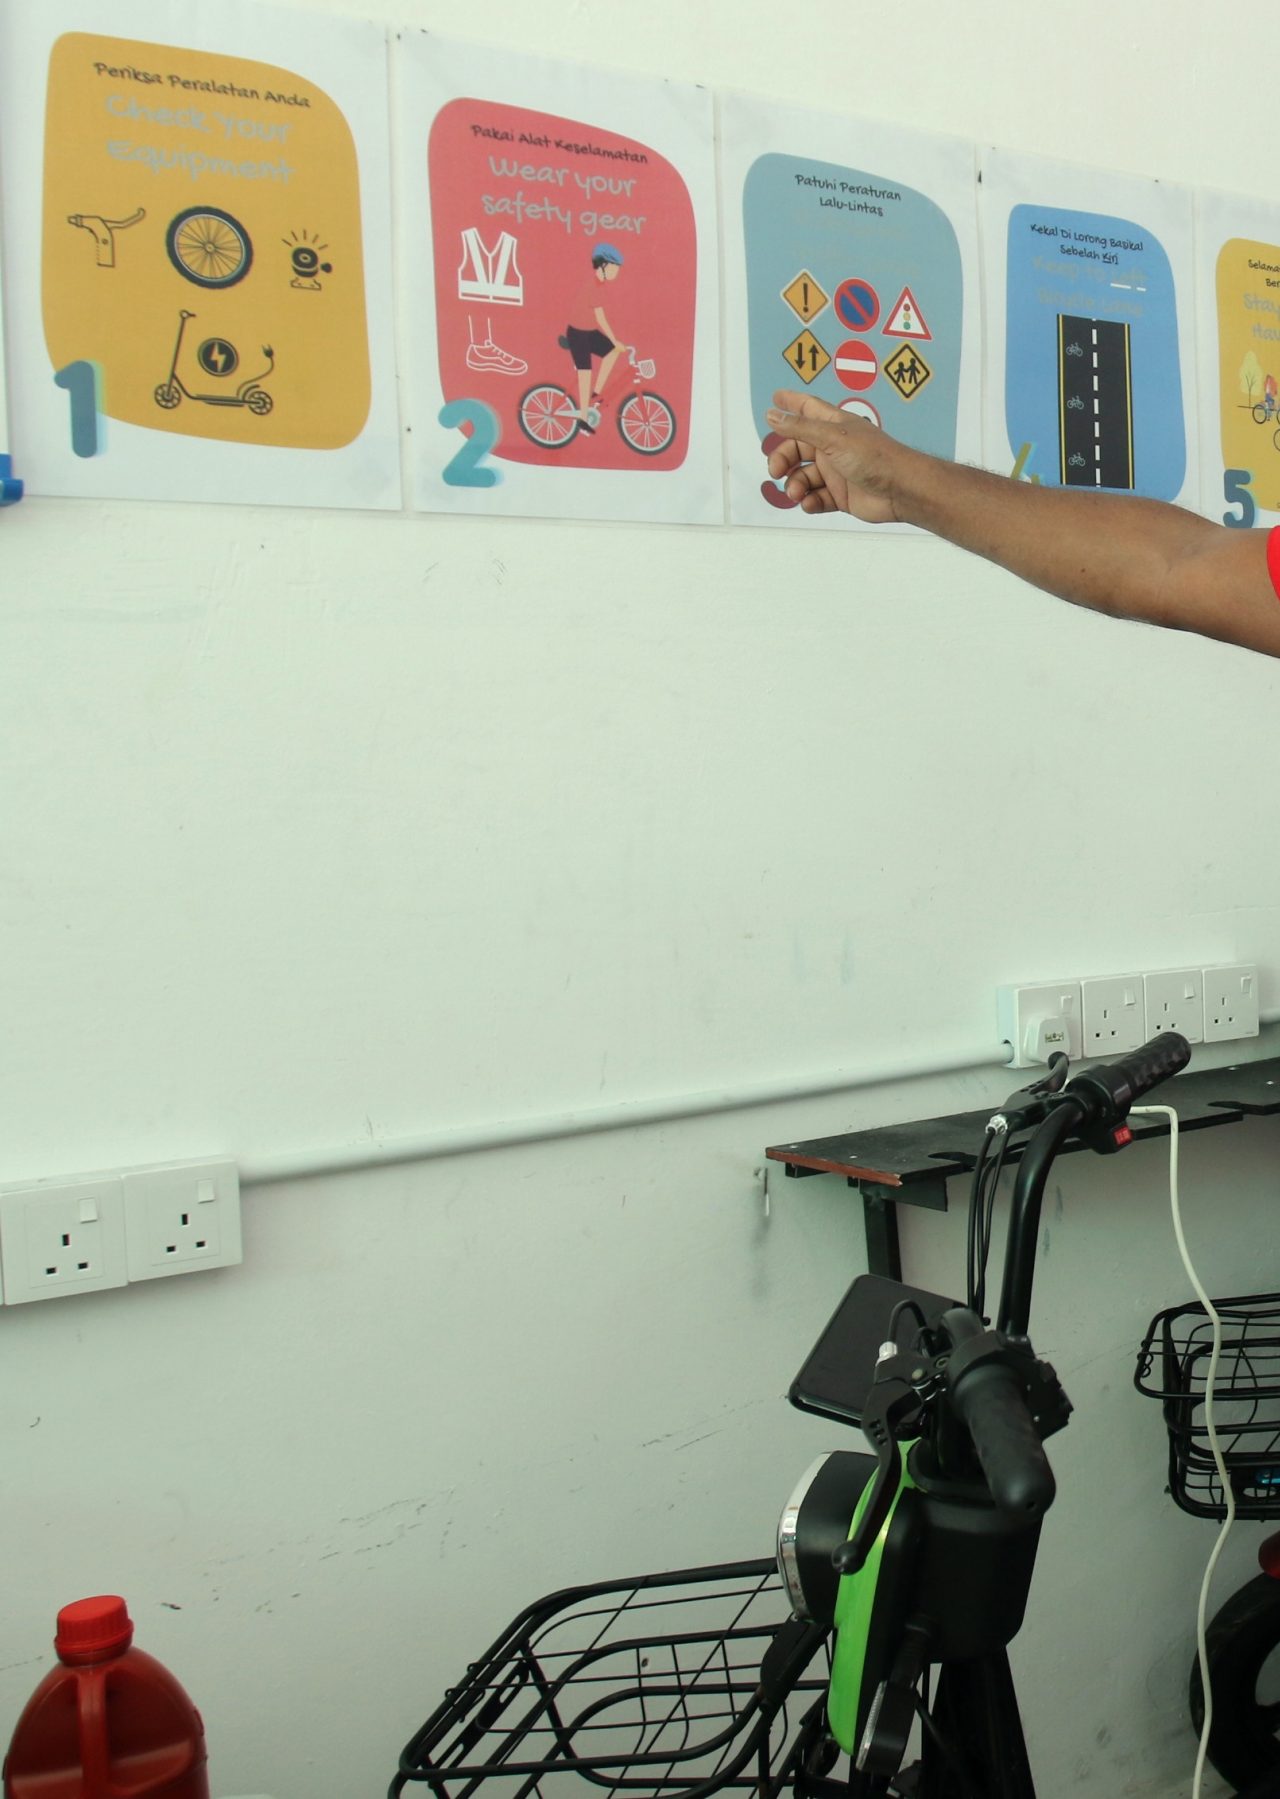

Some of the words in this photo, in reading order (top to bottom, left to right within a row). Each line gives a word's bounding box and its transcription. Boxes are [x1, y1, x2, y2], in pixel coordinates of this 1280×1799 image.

[93, 61, 162, 85] Periksa
[167, 74, 260, 101] Peralatan
[264, 89, 311, 108] Anda
[105, 94, 214, 134] Check
[213, 109, 293, 145] Your
[105, 138, 297, 186] Equipment
[471, 124, 514, 142] Pakai
[518, 133, 552, 149] Alat
[554, 139, 648, 164] Keselamatan
[574, 171, 638, 201] your
[794, 173, 837, 191] Patuhi
[839, 181, 902, 202] Peraturan
[819, 196, 884, 217] Lalu-Lintas
[481, 189, 573, 235] safety
[579, 209, 648, 237] gear
[1030, 223, 1058, 237] Kekal
[1060, 228, 1072, 240] Di
[1074, 231, 1108, 250] Lorong
[1109, 238, 1144, 252] Basikal
[1060, 244, 1100, 260] Sebelah
[54, 360, 102, 459] 1
[437, 397, 500, 489] 2
[1222, 468, 1255, 529] 5
